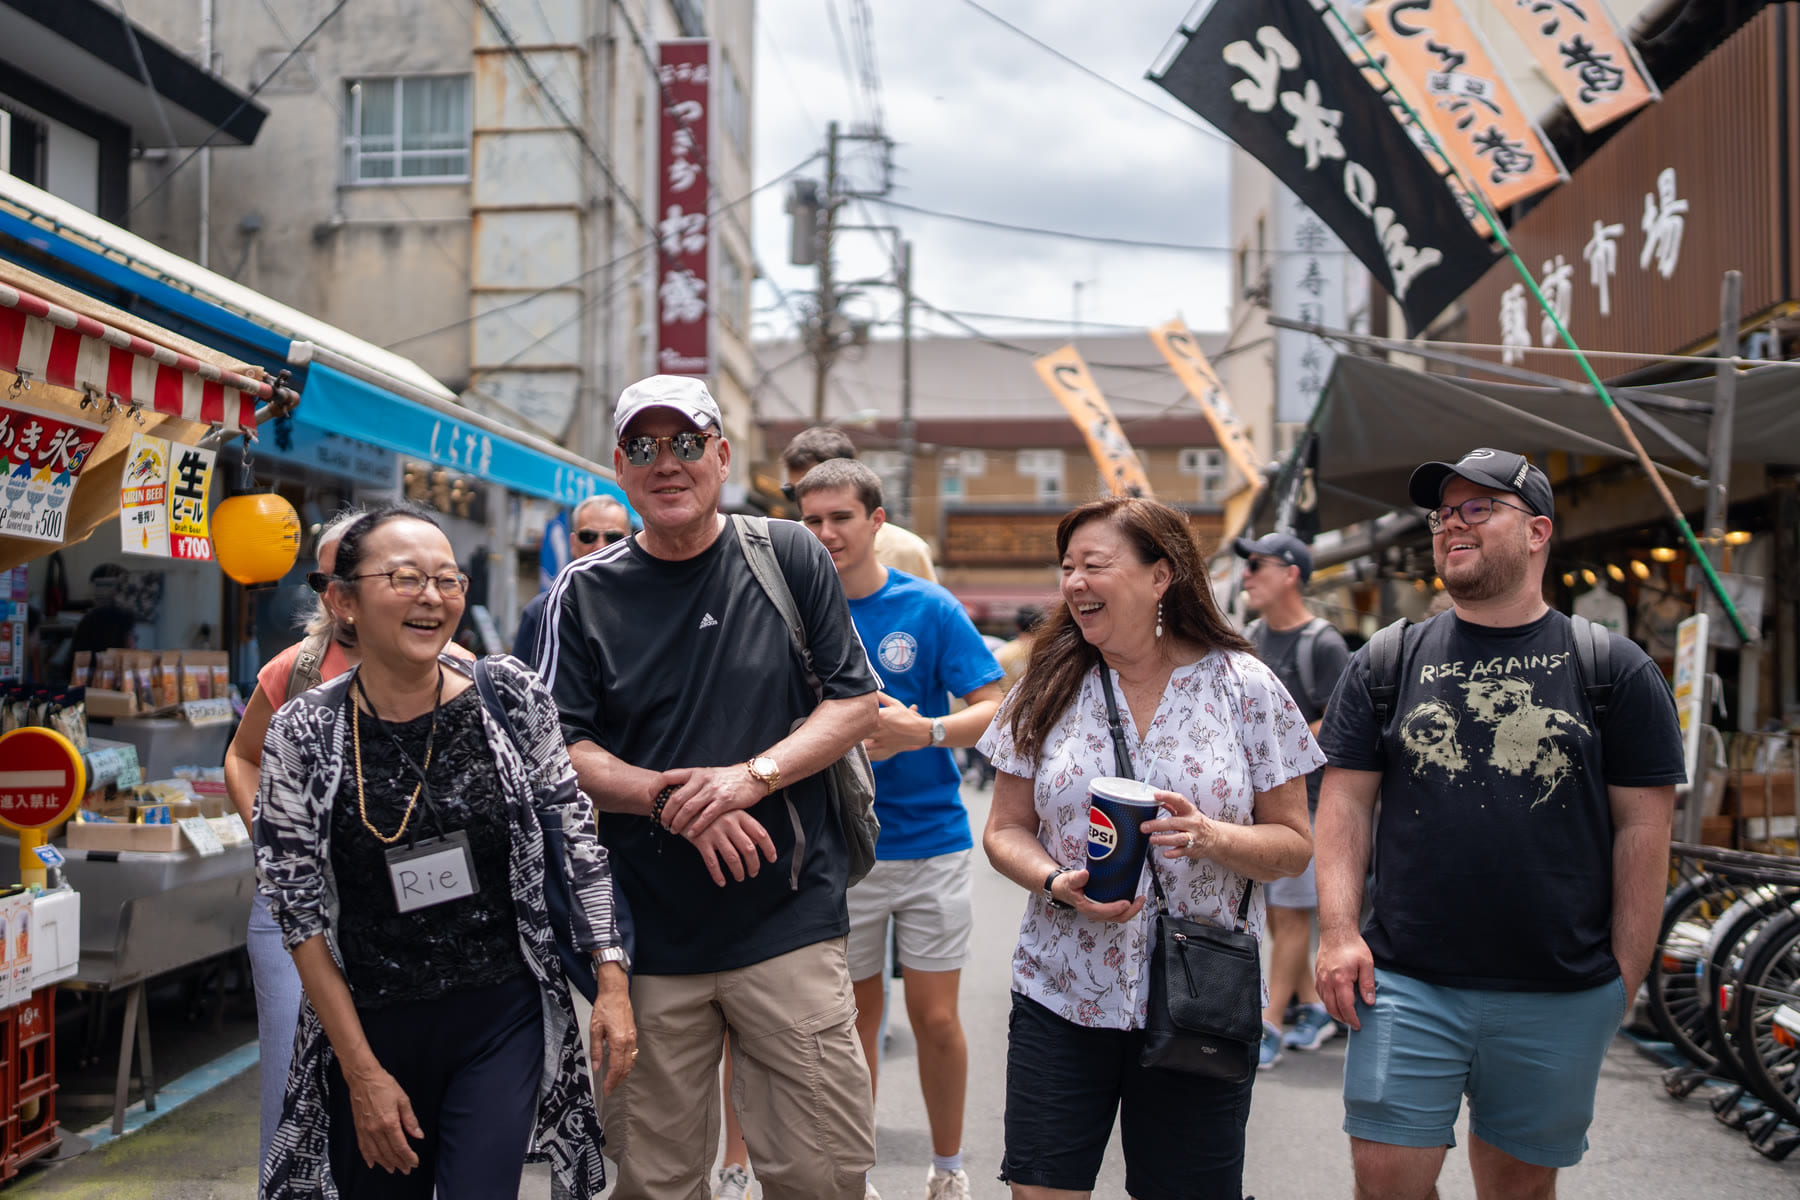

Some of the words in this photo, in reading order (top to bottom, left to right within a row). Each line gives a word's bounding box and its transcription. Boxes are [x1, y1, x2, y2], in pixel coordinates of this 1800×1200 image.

[175, 450, 208, 500] 生
[123, 489, 145, 505] KIRIN
[146, 486, 164, 503] BEER
[172, 497, 204, 523] ビール
[174, 523, 188, 533] Draft
[178, 536, 210, 559] ¥700
[1420, 661, 1467, 684] RISE
[1468, 651, 1571, 681] AGAINST
[0, 793, 60, 810] 進入禁止
[1089, 825, 1114, 845] EPSI
[398, 870, 458, 899] Rie
